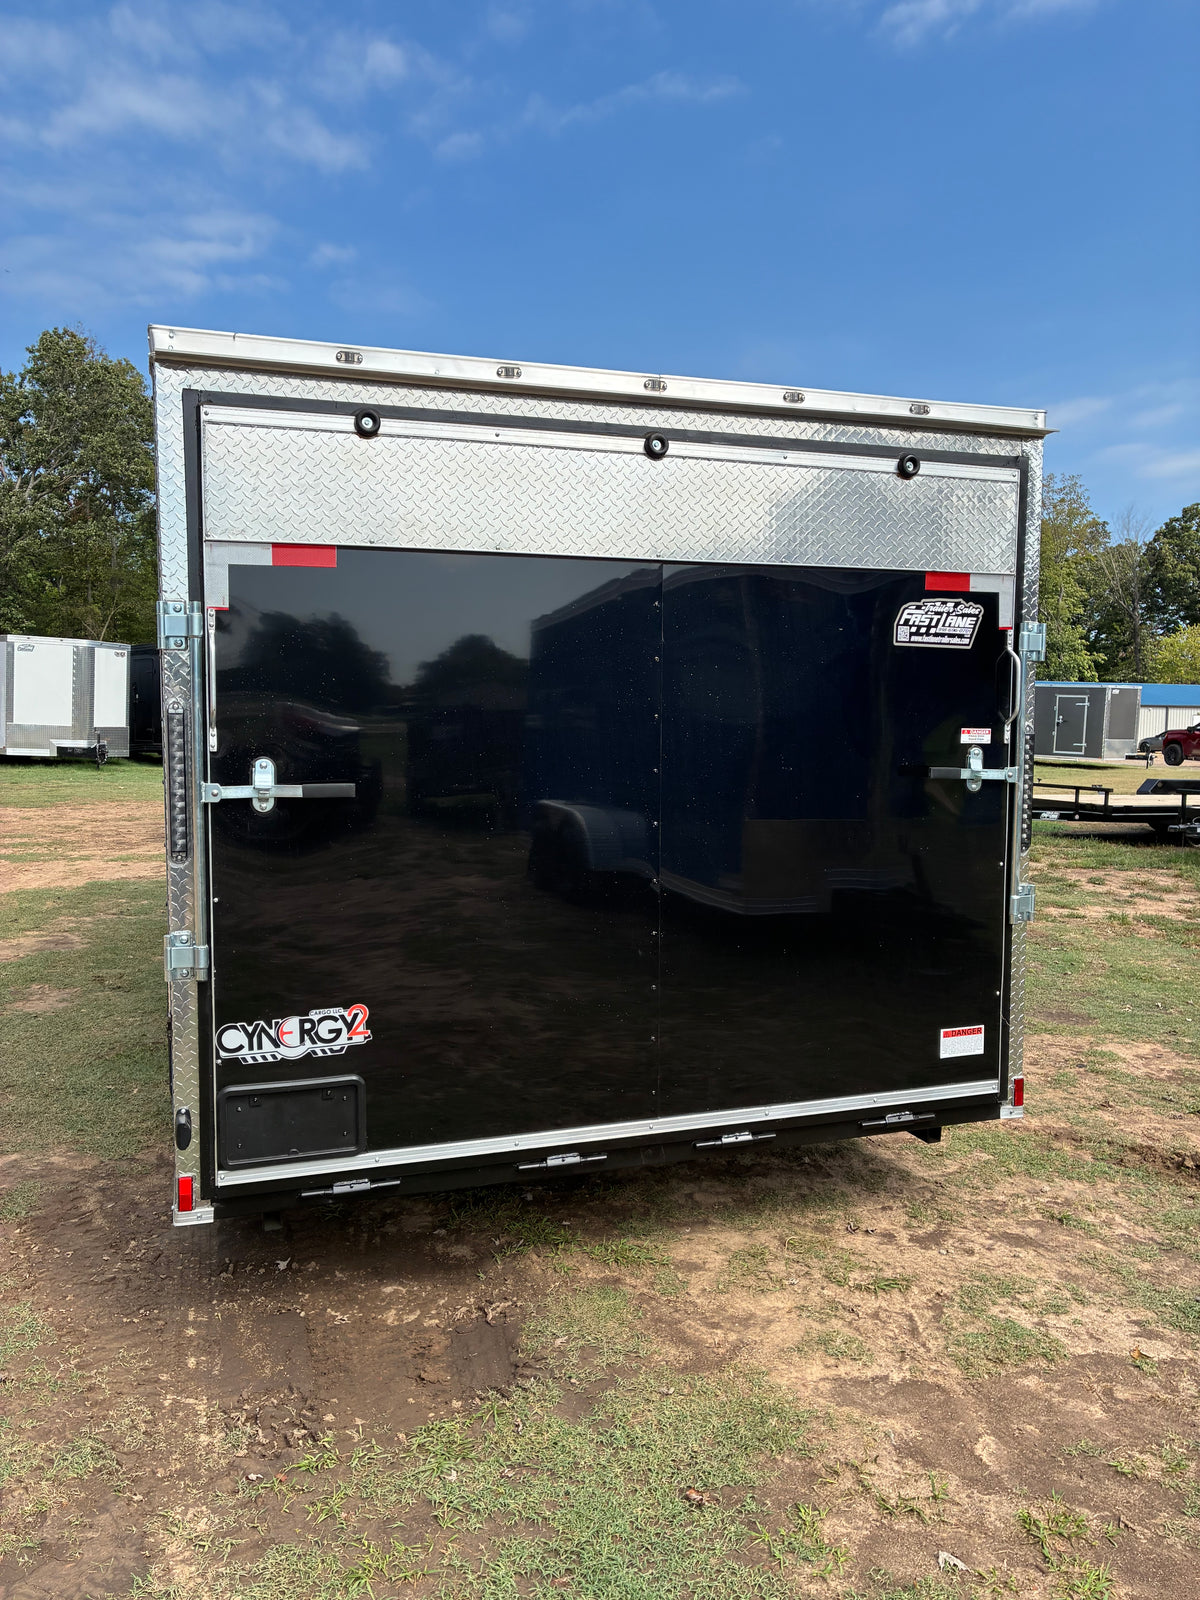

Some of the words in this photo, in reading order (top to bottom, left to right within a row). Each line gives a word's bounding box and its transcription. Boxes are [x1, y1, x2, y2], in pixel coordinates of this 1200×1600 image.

[924, 602, 954, 614] Trailer
[956, 604, 981, 615] Sales
[951, 1027, 982, 1037] DANGER
